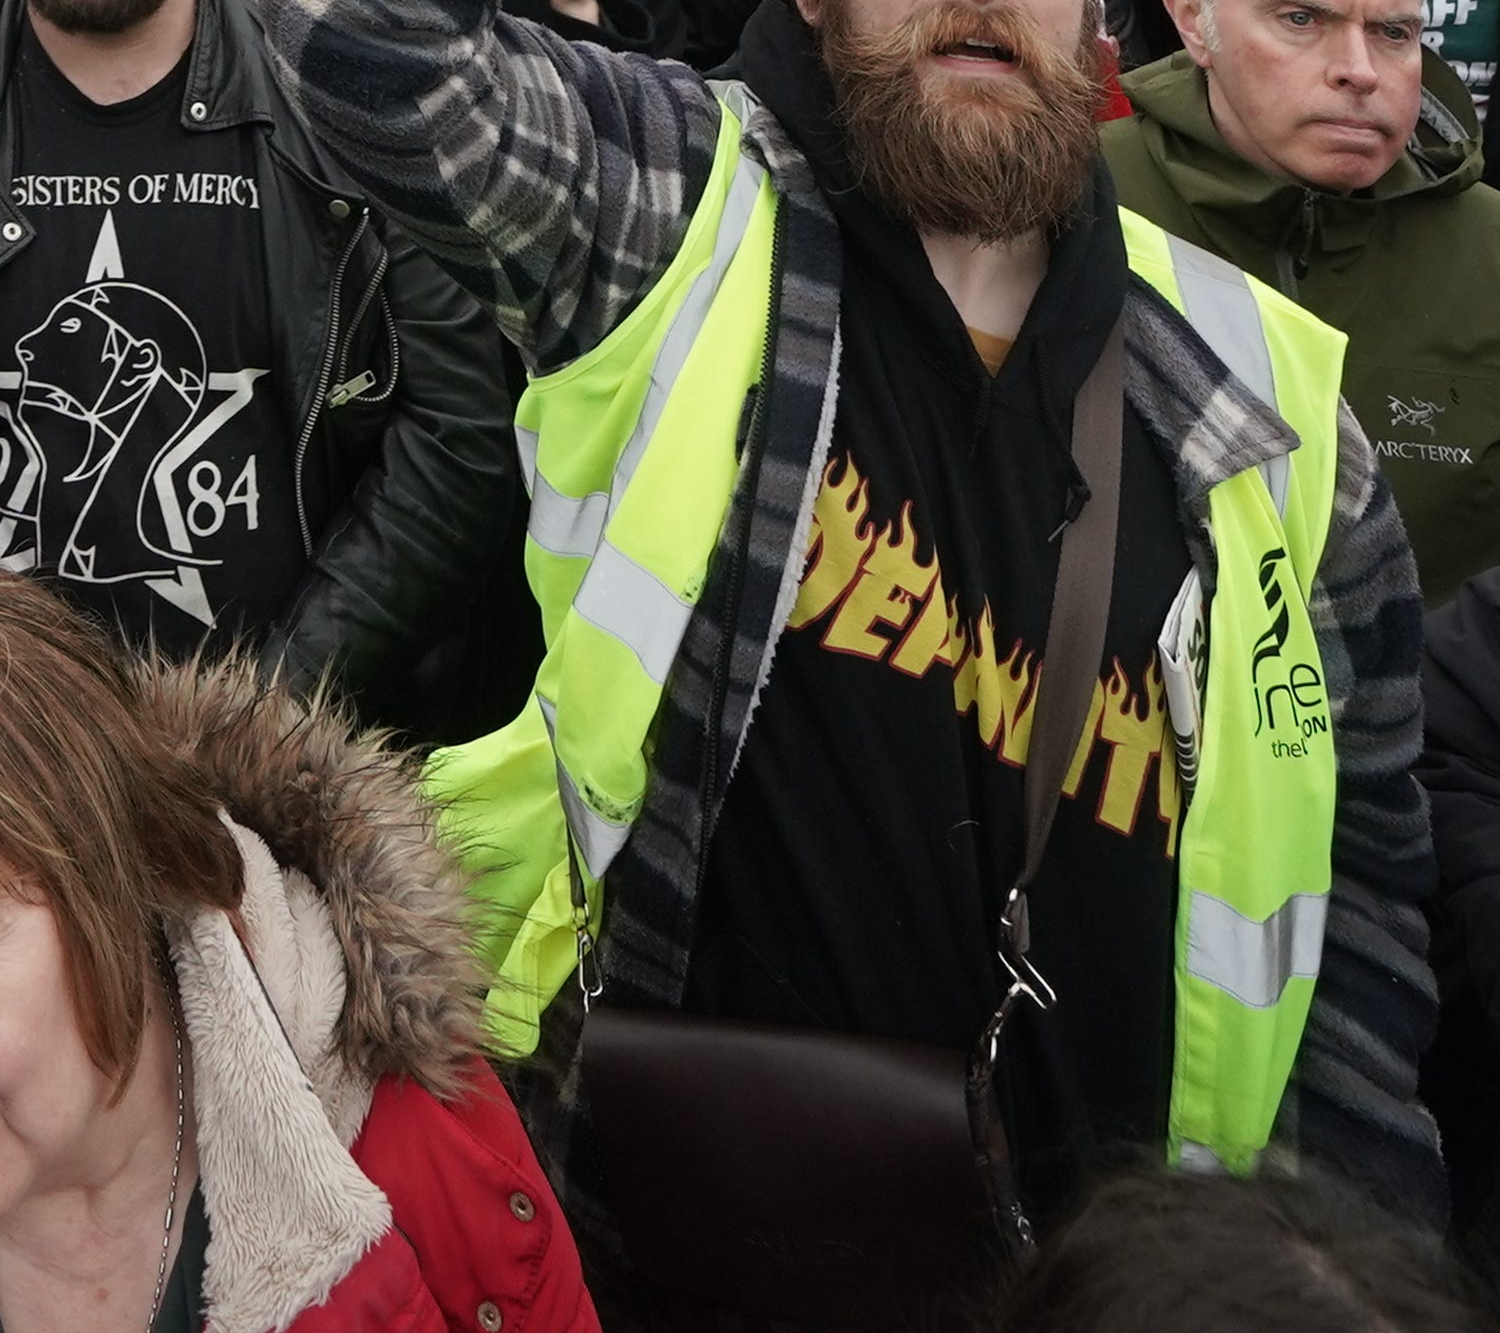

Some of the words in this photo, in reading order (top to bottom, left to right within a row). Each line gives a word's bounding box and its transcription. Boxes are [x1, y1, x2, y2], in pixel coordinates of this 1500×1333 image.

[11, 175, 120, 206] SISTERS
[128, 174, 169, 204] OF
[173, 173, 260, 209] MERCY
[1376, 440, 1474, 464] ARC'TERYX
[187, 454, 260, 537] 84
